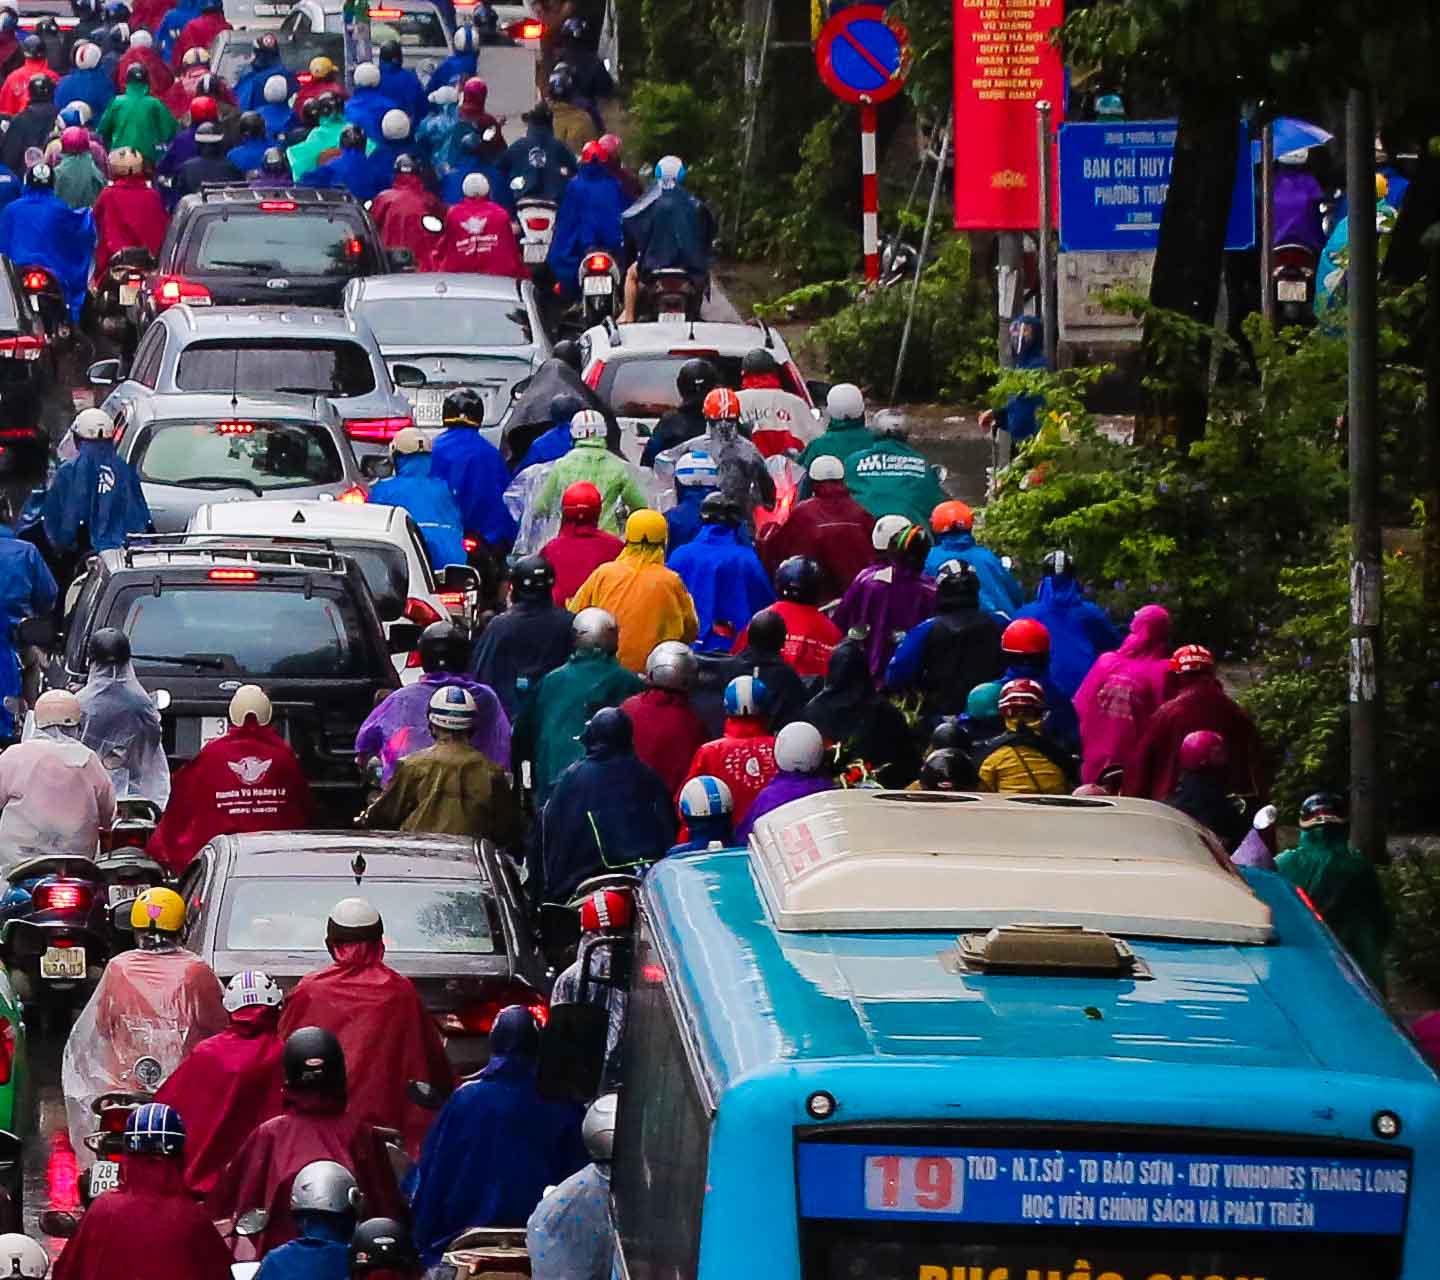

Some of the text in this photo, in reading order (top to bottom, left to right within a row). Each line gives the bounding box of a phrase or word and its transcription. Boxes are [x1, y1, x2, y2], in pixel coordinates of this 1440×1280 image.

[872, 1156, 953, 1209] 19
[966, 1155, 996, 1179] TKD
[1223, 1164, 1306, 1190] VINHOMES
[1365, 1168, 1409, 1194] LONG
[1151, 1193, 1196, 1223] SÁCH
